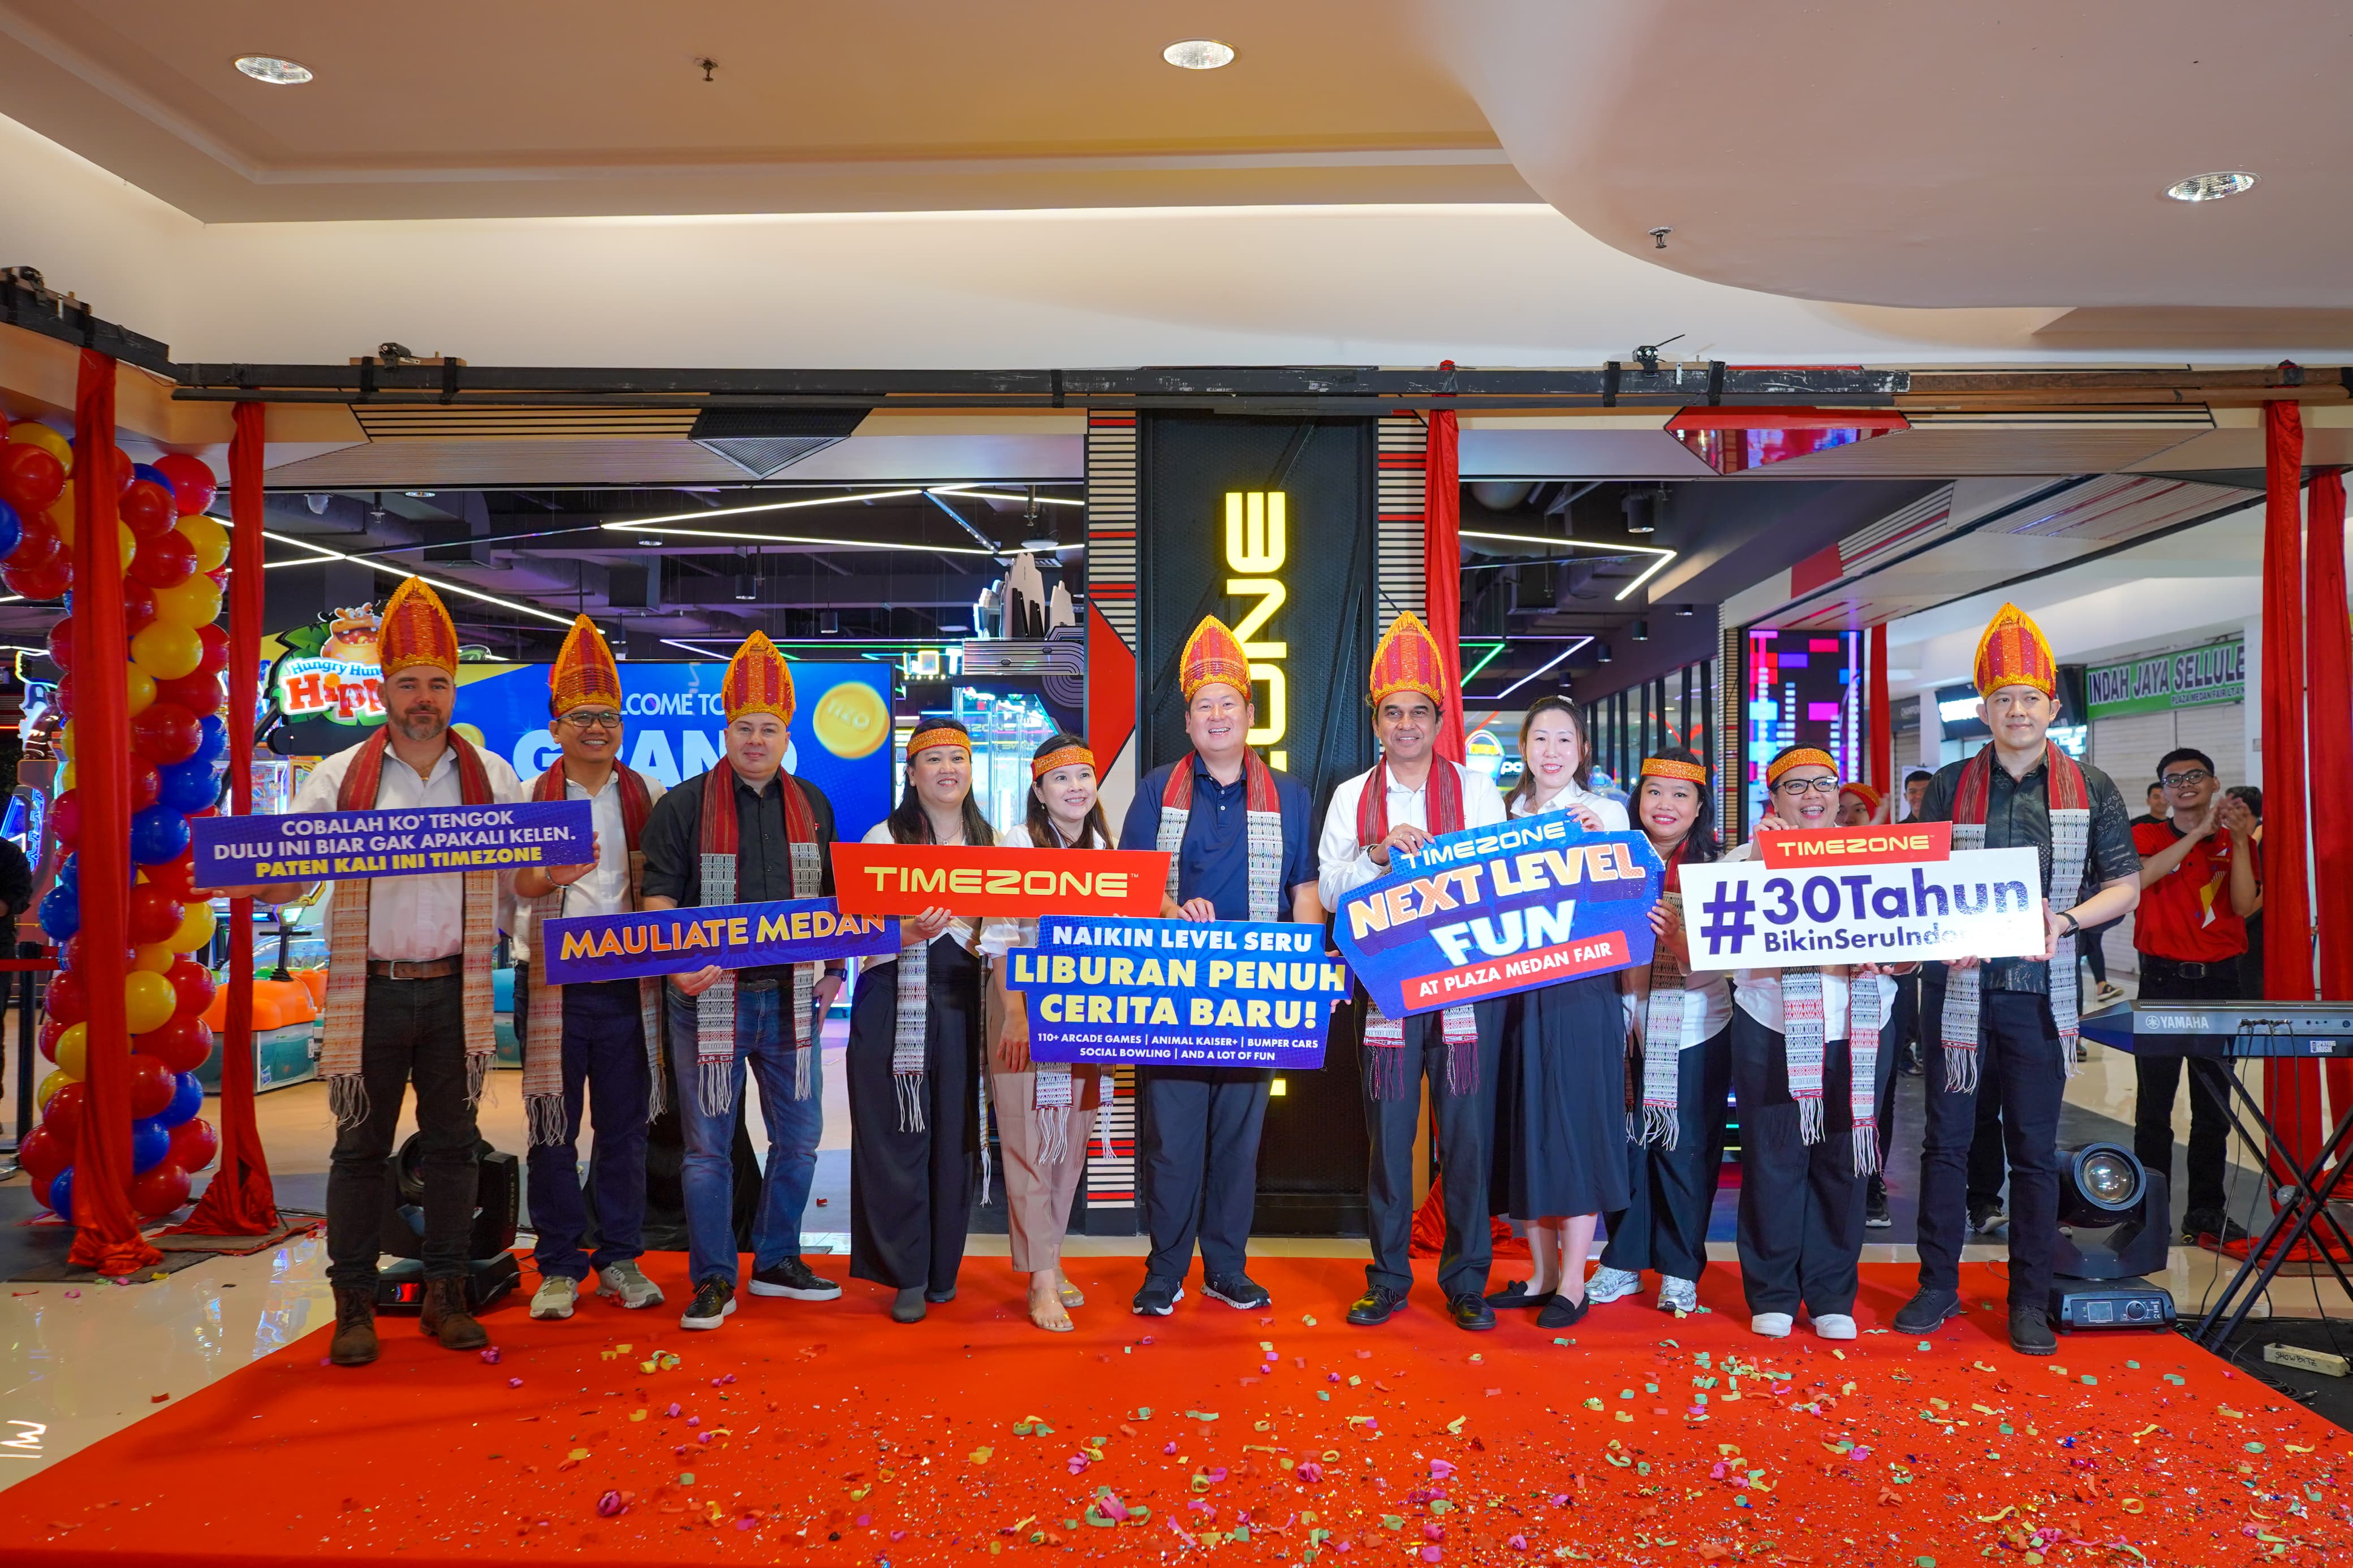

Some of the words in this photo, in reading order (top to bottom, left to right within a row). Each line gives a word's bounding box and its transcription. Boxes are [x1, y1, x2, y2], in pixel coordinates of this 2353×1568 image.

[291, 661, 347, 675] Hungry
[349, 664, 382, 676] Hun
[2089, 667, 2130, 705] INDAH
[2134, 659, 2170, 698] JAYA
[2174, 645, 2244, 692] SELLULE
[2172, 694, 2190, 706] PLAZA
[2192, 691, 2210, 702] MEDAN
[2212, 688, 2226, 700] FAIR
[281, 818, 383, 836] COBALAH
[389, 815, 425, 831] KO'
[429, 811, 514, 829] TENGOK
[214, 843, 273, 859] DULU
[279, 841, 310, 856] INI
[318, 837, 364, 854] BIAR
[369, 834, 413, 850] GAK
[420, 830, 505, 849] APAKALI
[509, 826, 576, 844] KELEN.
[1400, 821, 1567, 869] TIMEZONE
[1777, 835, 1930, 857] TIMEZONE
[256, 858, 328, 878] PATEN
[334, 856, 386, 874] KALI
[392, 853, 425, 869] INI
[429, 847, 542, 869] TIMEZONE
[864, 867, 1128, 897] TIMEZONE
[1347, 863, 1483, 940] NEXT
[1489, 843, 1646, 897] LEVEL
[1700, 867, 2029, 955] #30Tahun
[560, 917, 749, 960] MAULIATE
[756, 910, 886, 943] MEDAN
[1053, 926, 1154, 948] NAIKIN
[1160, 929, 1238, 950] LEVEL
[1244, 932, 1312, 952] SERU
[1429, 899, 1576, 967] FUN
[1014, 955, 1196, 987] LIBURAN
[1209, 960, 1346, 992] PENUH
[1420, 980, 1438, 997] AT
[1445, 966, 1502, 991] PLAZA
[1506, 951, 1570, 978] MEDAN
[1575, 941, 1613, 962] FAIR
[1040, 994, 1179, 1026] CERITA
[1190, 999, 1317, 1029] BARU!
[2161, 1016, 2209, 1029] YAMAHA
[1038, 1033, 1059, 1043] 110+
[1061, 1034, 1104, 1044] ARCADE
[1105, 1034, 1141, 1044] GAMES
[1152, 1036, 1194, 1046] ANIMAL
[1196, 1036, 1238, 1047] KAISER+
[1247, 1038, 1290, 1048] BUMPER
[1292, 1039, 1318, 1048] CARS
[1080, 1047, 1118, 1057] SOCIAL
[1120, 1048, 1171, 1059] BOWLING
[1180, 1049, 1204, 1059] AND
[1205, 1050, 1215, 1059] A
[1217, 1050, 1238, 1060] LOT
[1239, 1051, 1253, 1060] OF
[1254, 1051, 1275, 1061] FUN
